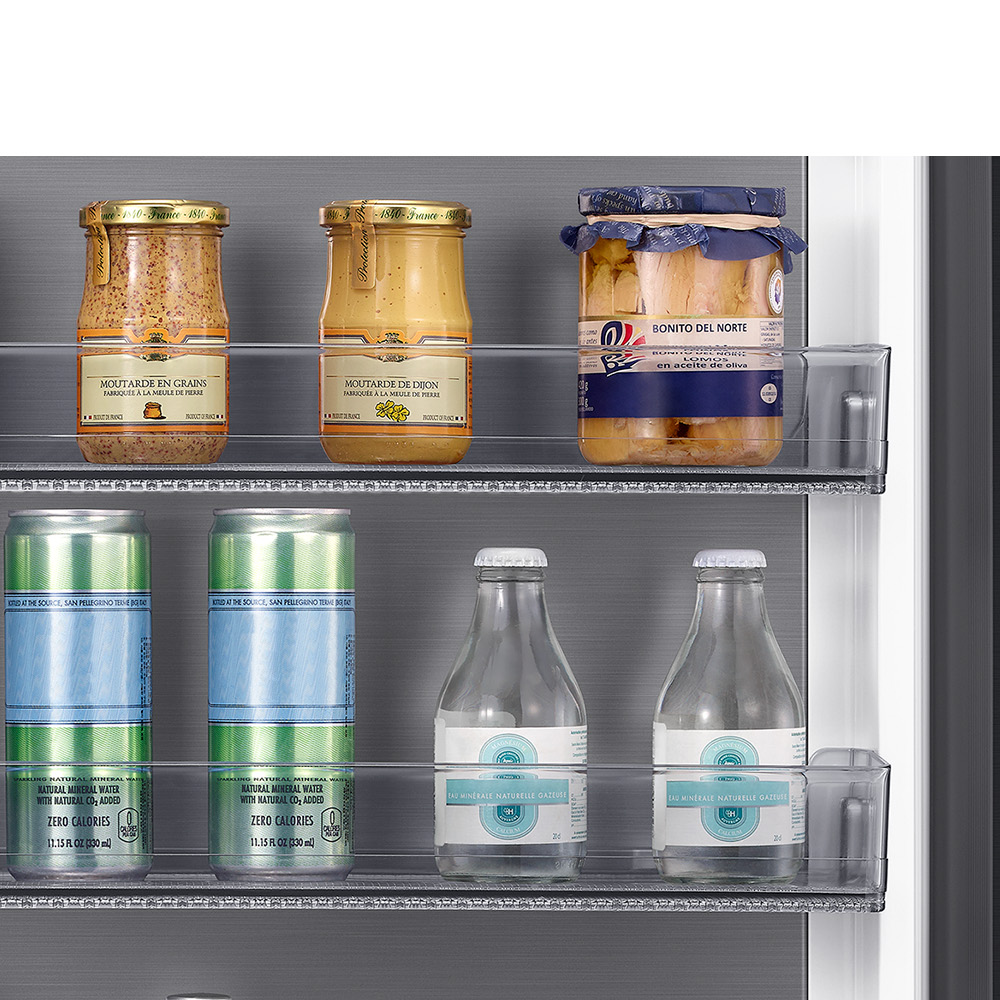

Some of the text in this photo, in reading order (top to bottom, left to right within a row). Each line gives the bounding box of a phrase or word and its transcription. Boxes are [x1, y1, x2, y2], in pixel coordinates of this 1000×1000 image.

[148, 206, 180, 220] France
[379, 206, 439, 220] 1840 France
[357, 228, 369, 282] Protection
[652, 323, 747, 333] BONITO DEL NORTE
[100, 379, 207, 388] MOUTARDE EN GRAINS
[344, 379, 439, 390] MOUTARDE DE DIJON
[38, 785, 119, 794] NATURAL MINERAL WATER
[241, 784, 323, 793] NATURAL MINERAL WATER
[37, 796, 120, 805] WITH NATURAL ADDED
[240, 795, 324, 804] WITH NATURAL ADDED
[460, 791, 493, 800] MINÉRALE
[681, 793, 714, 802] MINÉRALE
[48, 816, 110, 827] ZERO CALORIES
[251, 815, 314, 826] ZERO CALORIES
[47, 838, 64, 848] 11.15
[65, 838, 73, 848] FL
[74, 838, 84, 848] OZ
[85, 838, 100, 849] (330
[250, 837, 268, 847] 11.15
[269, 838, 276, 847] FL
[278, 838, 287, 847] OZ
[289, 838, 303, 848] (330
